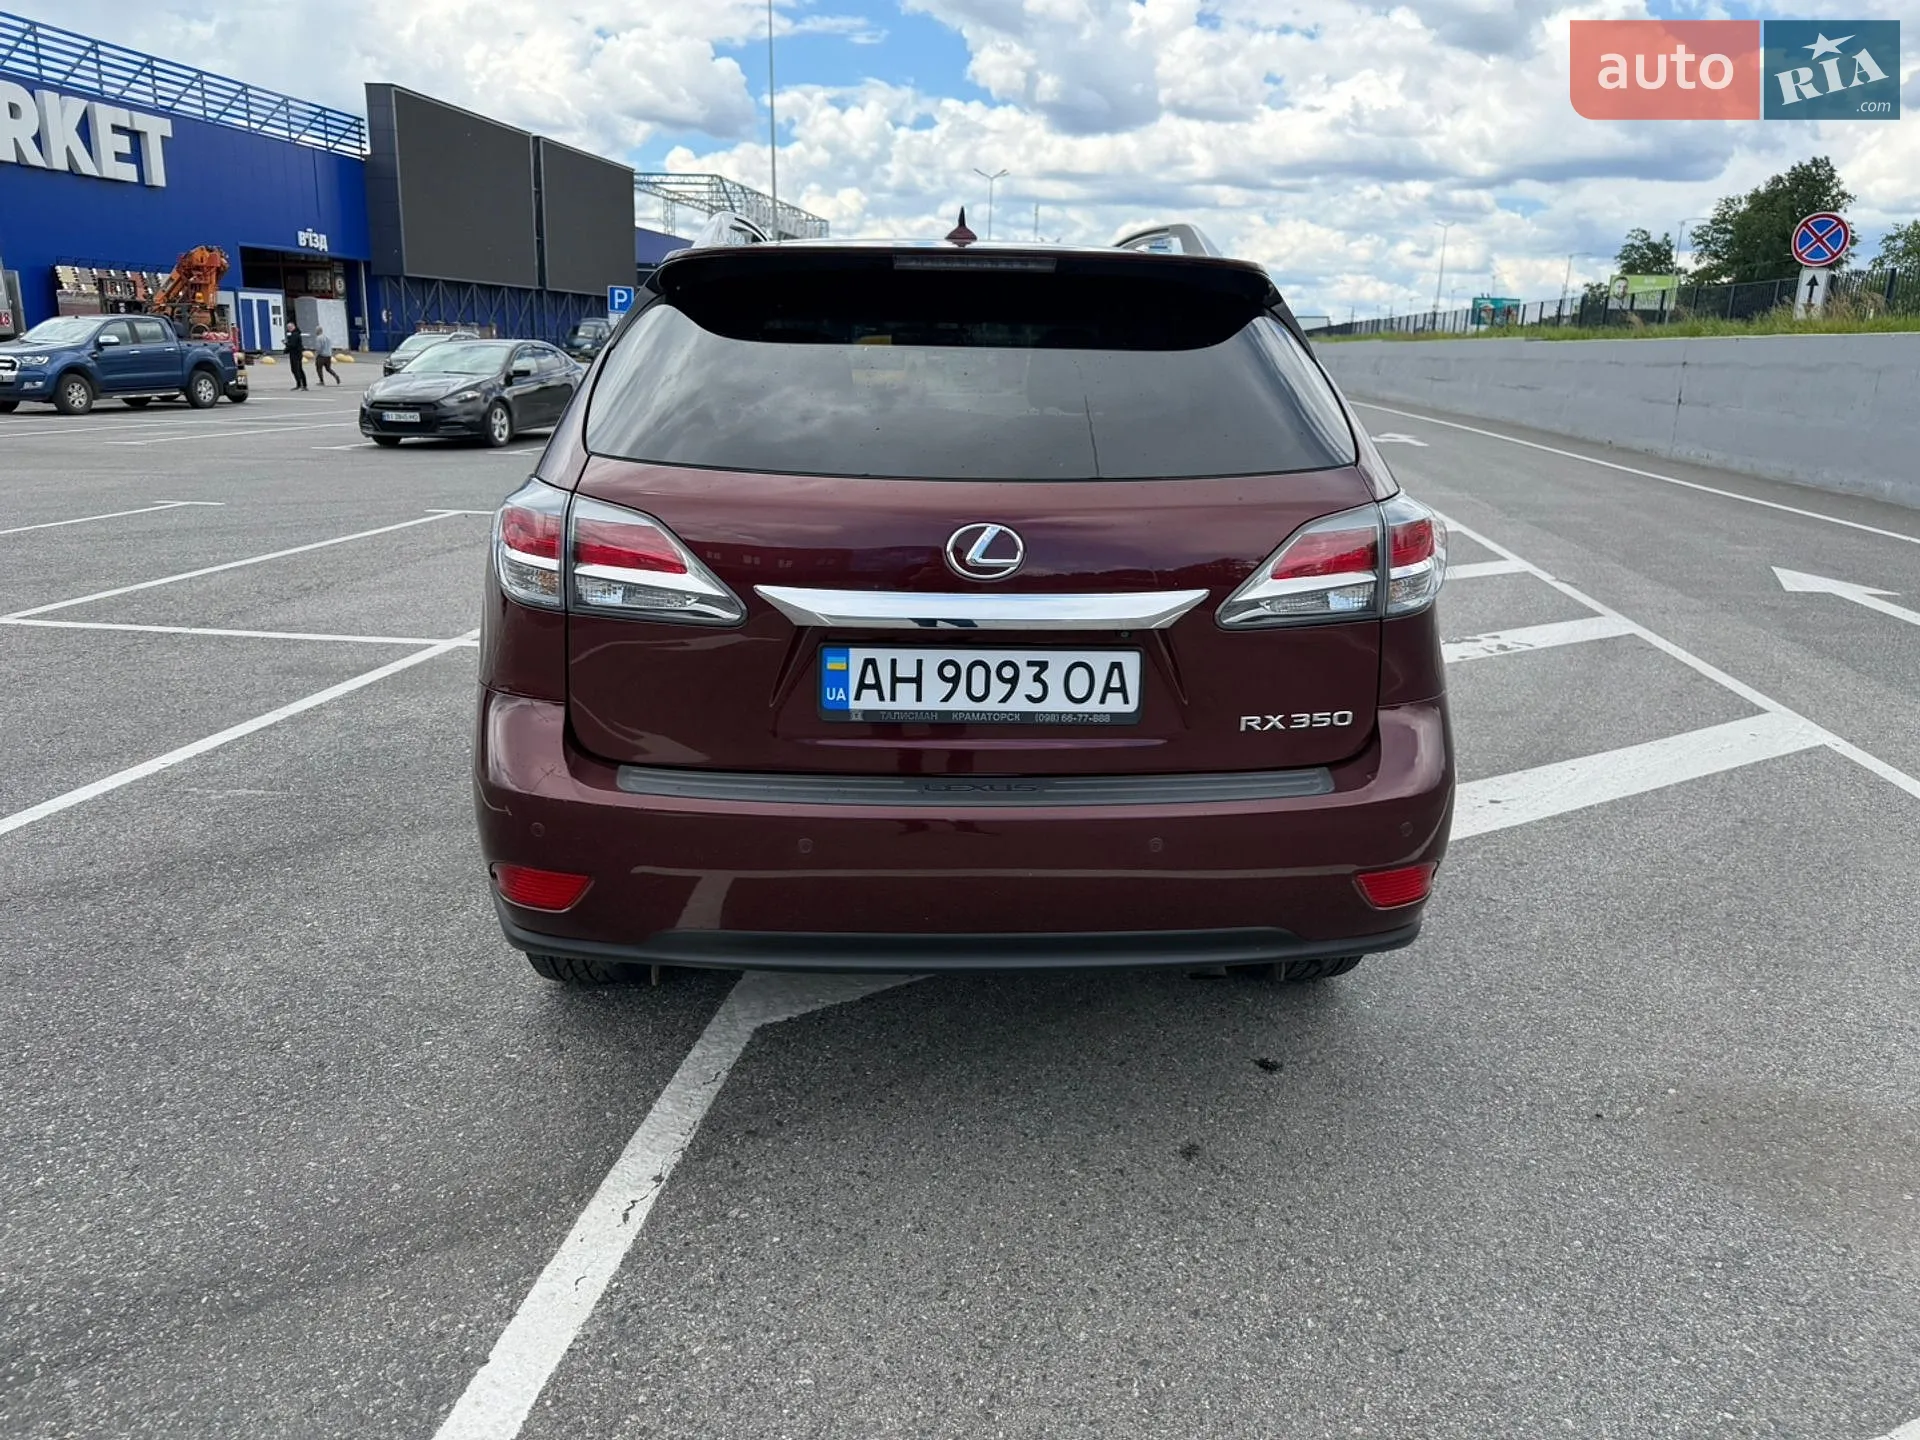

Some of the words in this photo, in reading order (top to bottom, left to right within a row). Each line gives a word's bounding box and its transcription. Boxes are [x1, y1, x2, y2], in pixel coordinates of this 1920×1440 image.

[0, 79, 172, 188] RKET
[614, 289, 628, 309] P
[853, 657, 923, 702] AH
[937, 658, 1049, 704] 9093
[1063, 660, 1130, 705] OA
[826, 687, 847, 701] UA
[951, 712, 1021, 722] КРАМАТОРСК
[1239, 714, 1286, 732] RX
[1289, 710, 1353, 729] 350
